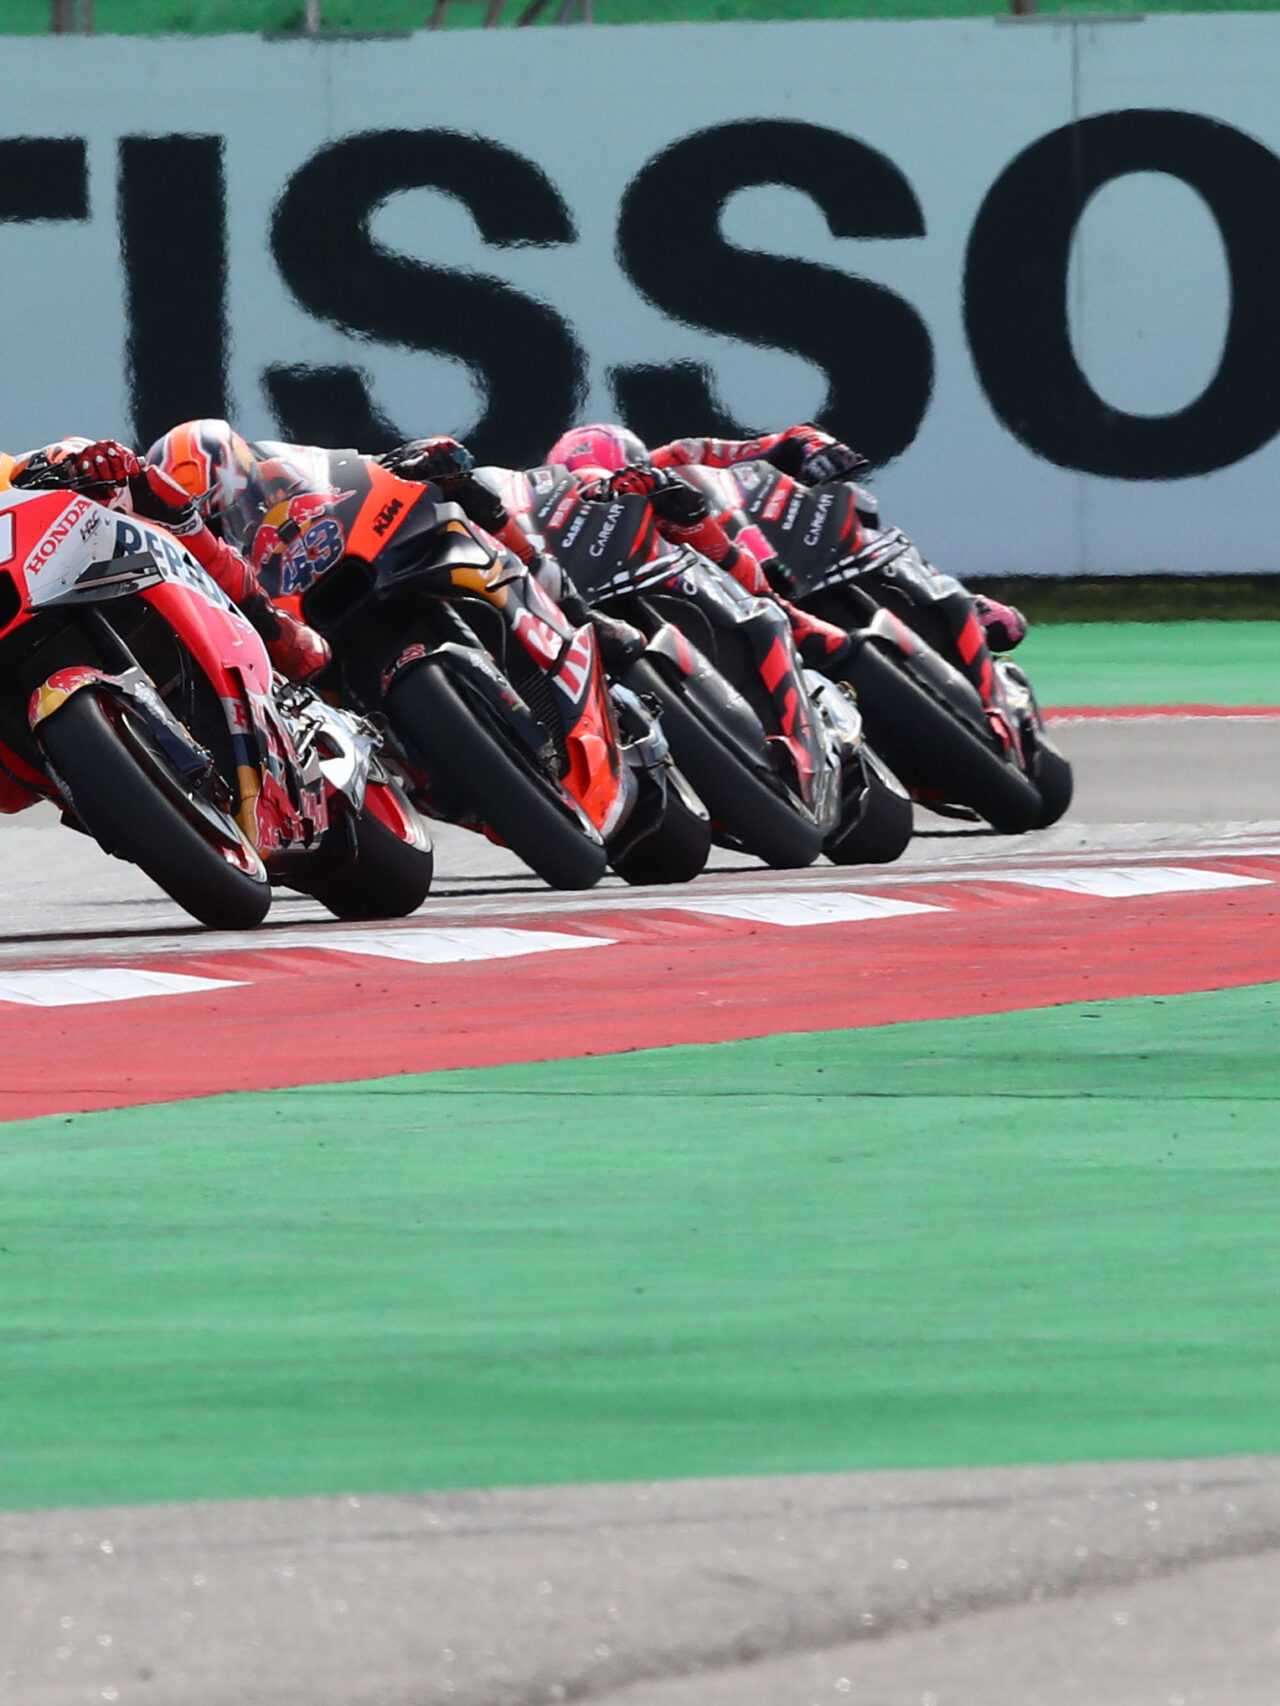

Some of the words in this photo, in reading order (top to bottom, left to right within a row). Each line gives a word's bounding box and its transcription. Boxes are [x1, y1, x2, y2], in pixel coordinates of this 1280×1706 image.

[27, 500, 93, 576] HONDA
[373, 498, 404, 537] KTM
[280, 517, 345, 595] 43
